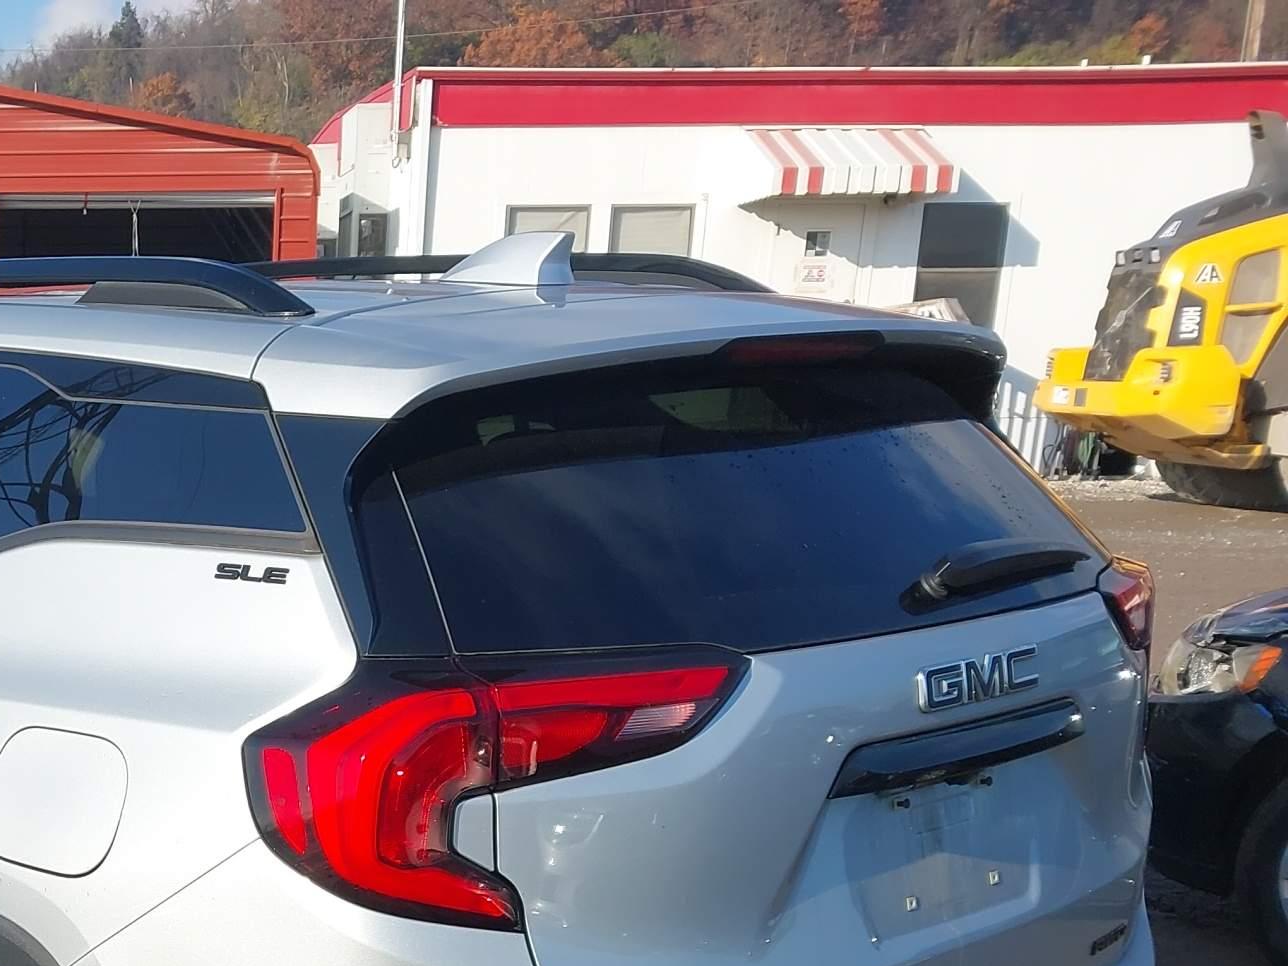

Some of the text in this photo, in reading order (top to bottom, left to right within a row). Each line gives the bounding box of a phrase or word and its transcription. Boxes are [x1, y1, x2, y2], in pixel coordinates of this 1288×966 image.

[1179, 306, 1202, 339] L90H
[214, 562, 290, 585] SLE
[915, 643, 1040, 714] GMC
